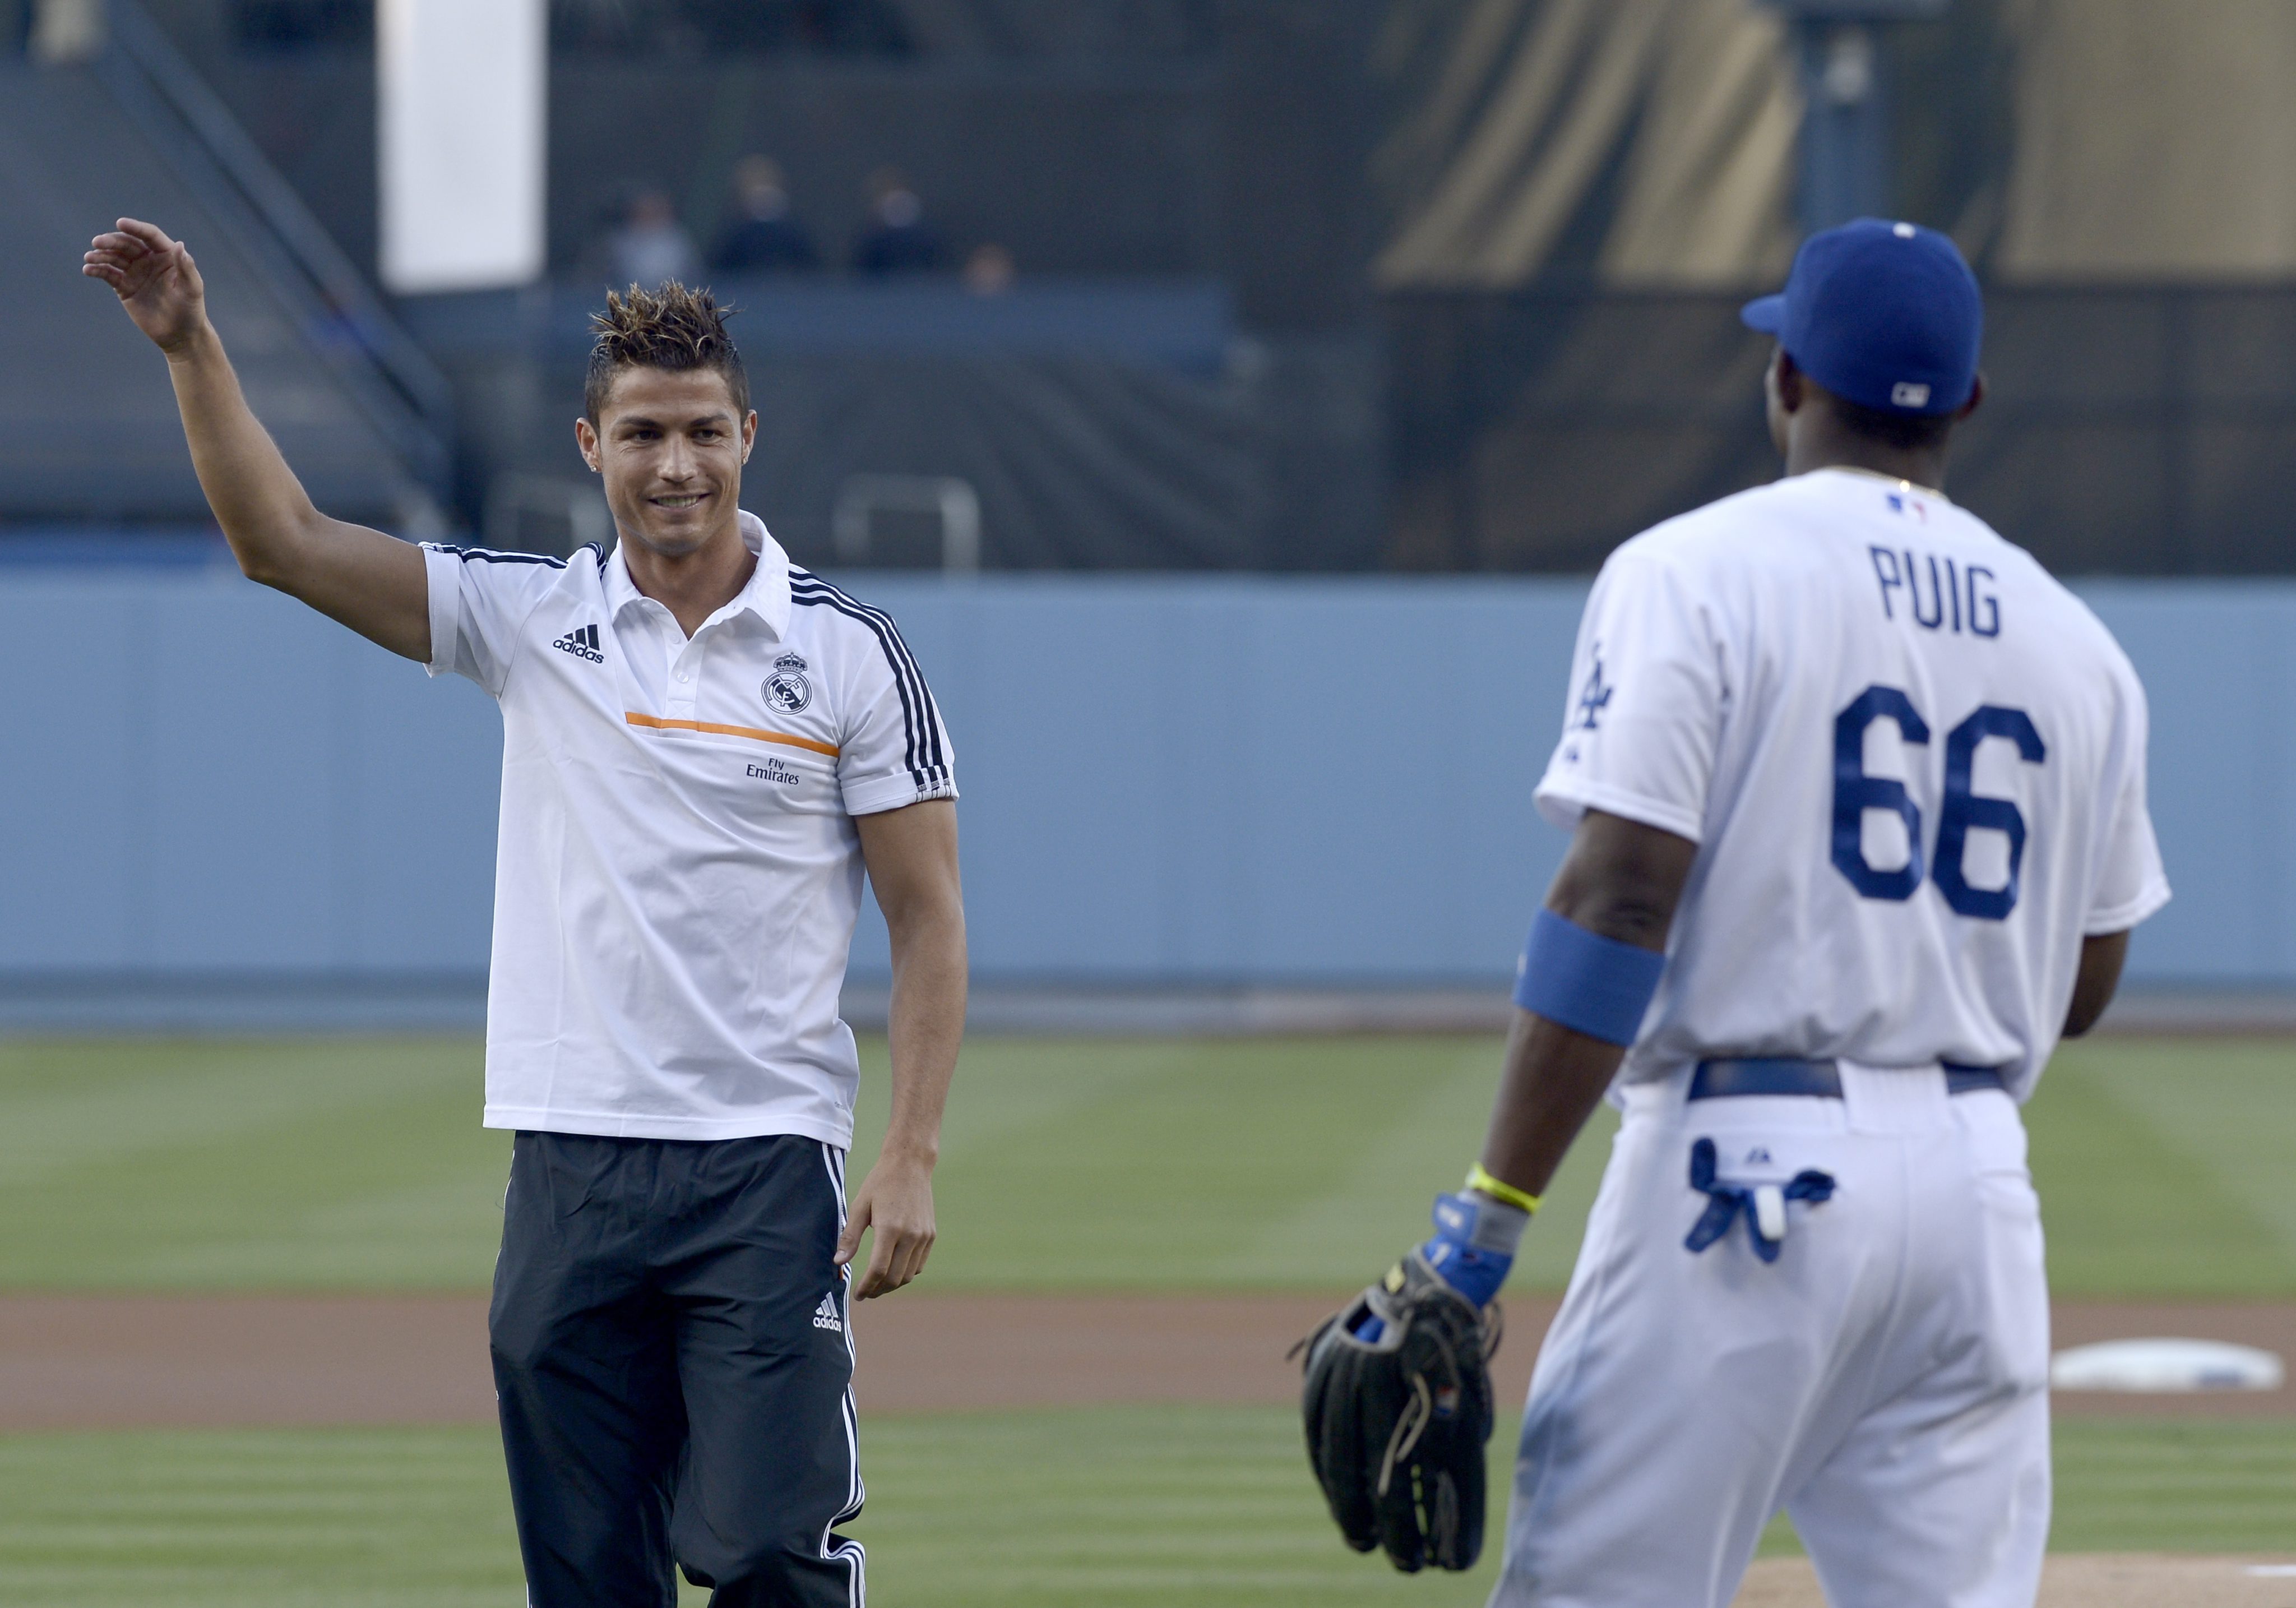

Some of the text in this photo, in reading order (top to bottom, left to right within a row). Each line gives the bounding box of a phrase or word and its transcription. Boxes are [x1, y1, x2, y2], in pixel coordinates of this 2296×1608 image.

[1869, 545, 1999, 638] PUIG
[553, 639, 604, 664] adidas
[746, 764, 799, 785] Emirates
[768, 758, 784, 770] Fly
[1831, 683, 2046, 922] 66
[813, 1315, 842, 1333] adidas
